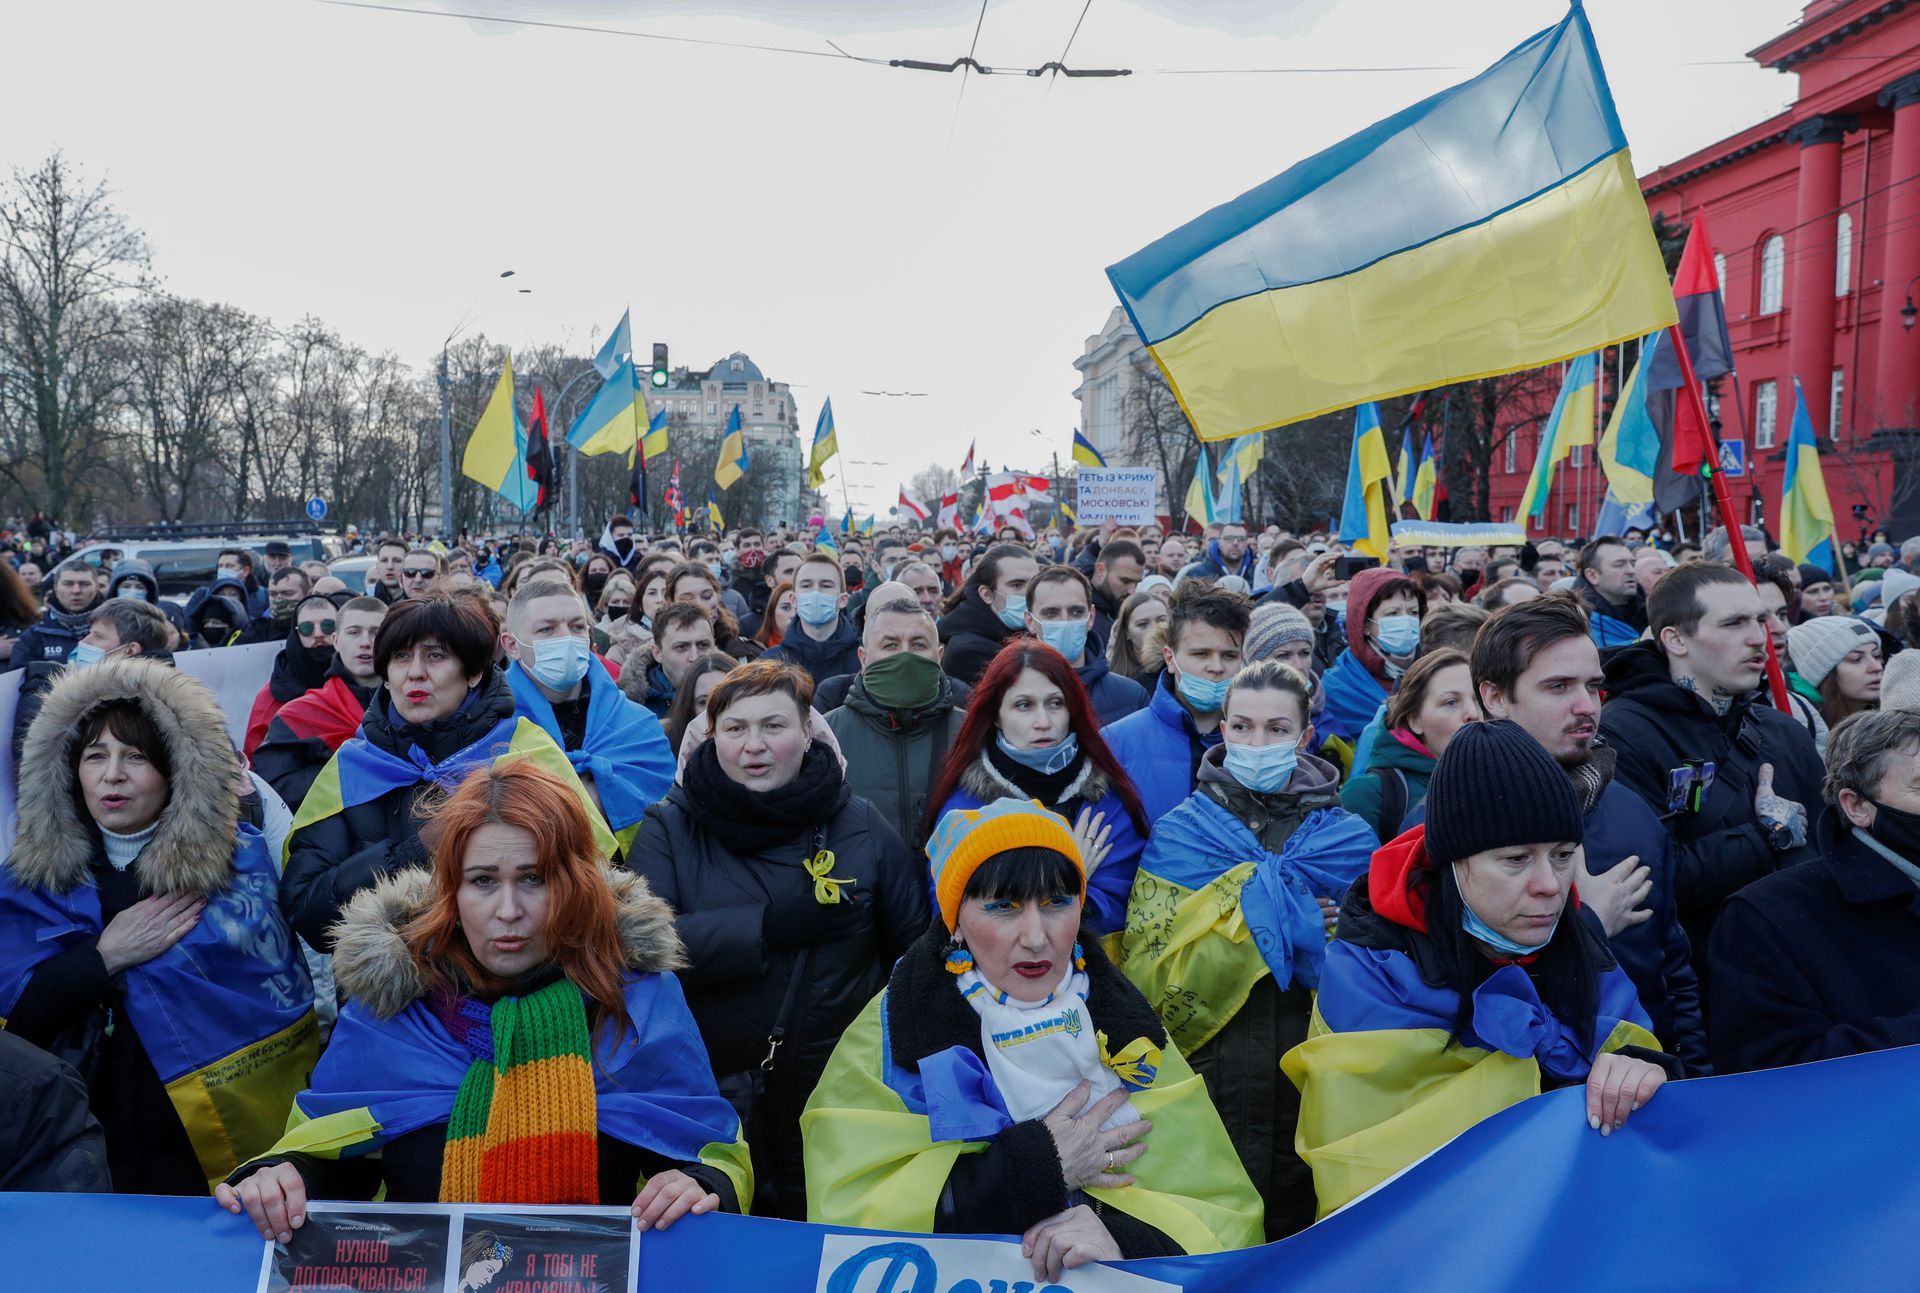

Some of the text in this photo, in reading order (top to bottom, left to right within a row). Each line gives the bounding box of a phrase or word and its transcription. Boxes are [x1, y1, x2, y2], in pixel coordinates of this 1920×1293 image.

[1079, 473, 1155, 482] ГЕТЬ ІЗ КРИМУ
[1079, 486, 1091, 494] ТА
[1080, 499, 1149, 508] МОСКОВСЬКІ
[335, 1239, 389, 1264] НУЖНО
[526, 1254, 598, 1277] Я ТОБІ НЕ
[289, 1266, 427, 1293] ДОГОВАРИВАТЬСЯ!
